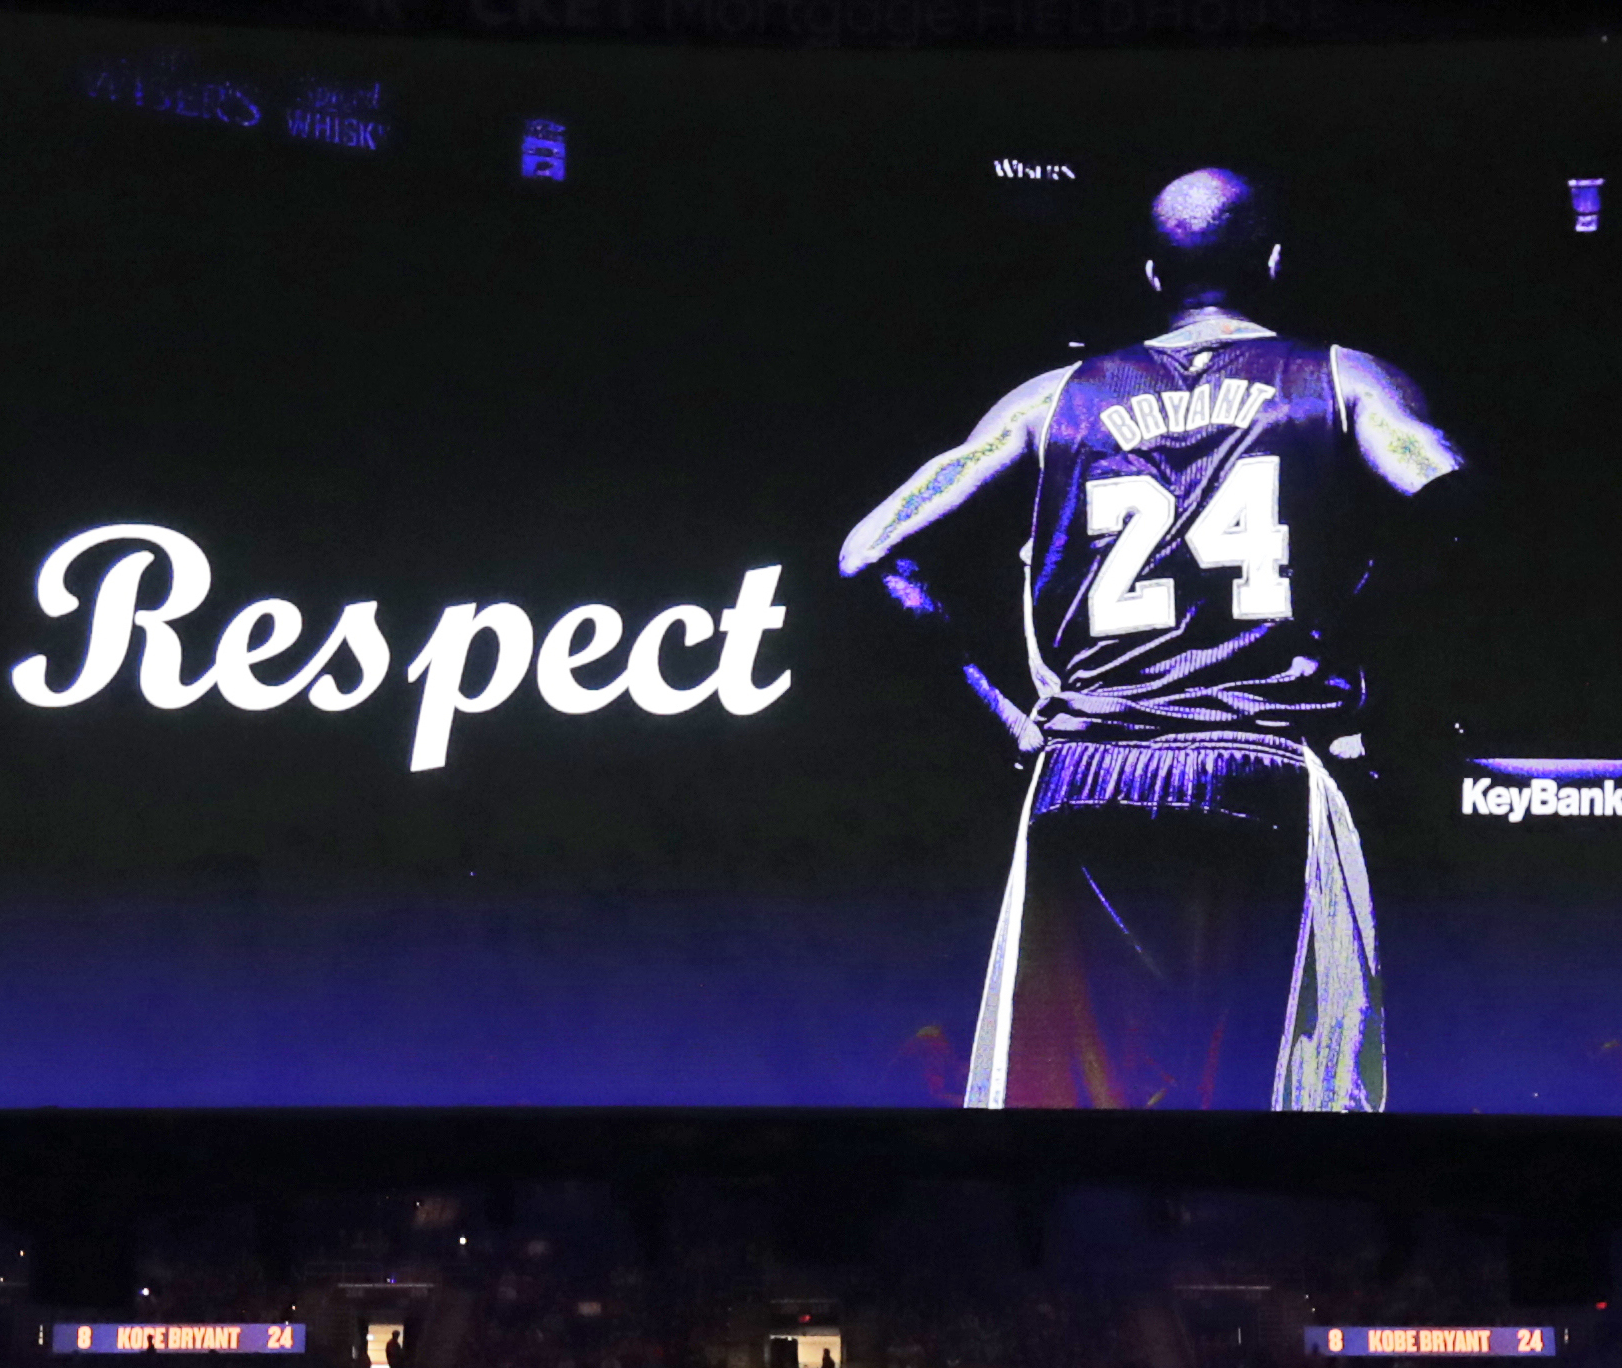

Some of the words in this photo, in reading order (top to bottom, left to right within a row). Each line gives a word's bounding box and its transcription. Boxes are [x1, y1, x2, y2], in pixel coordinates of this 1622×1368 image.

[286, 108, 386, 150] WHISK
[1099, 378, 1276, 451] BRYANT
[1086, 455, 1293, 637] 24
[10, 522, 792, 772] Respect
[77, 1327, 92, 1349] 8
[168, 1327, 240, 1349] BRYANT
[268, 1326, 293, 1349] 24
[1328, 1329, 1343, 1352] 8
[1368, 1330, 1417, 1352] KOBE
[1420, 1330, 1490, 1352] BRYANT
[1517, 1329, 1542, 1352] 24
